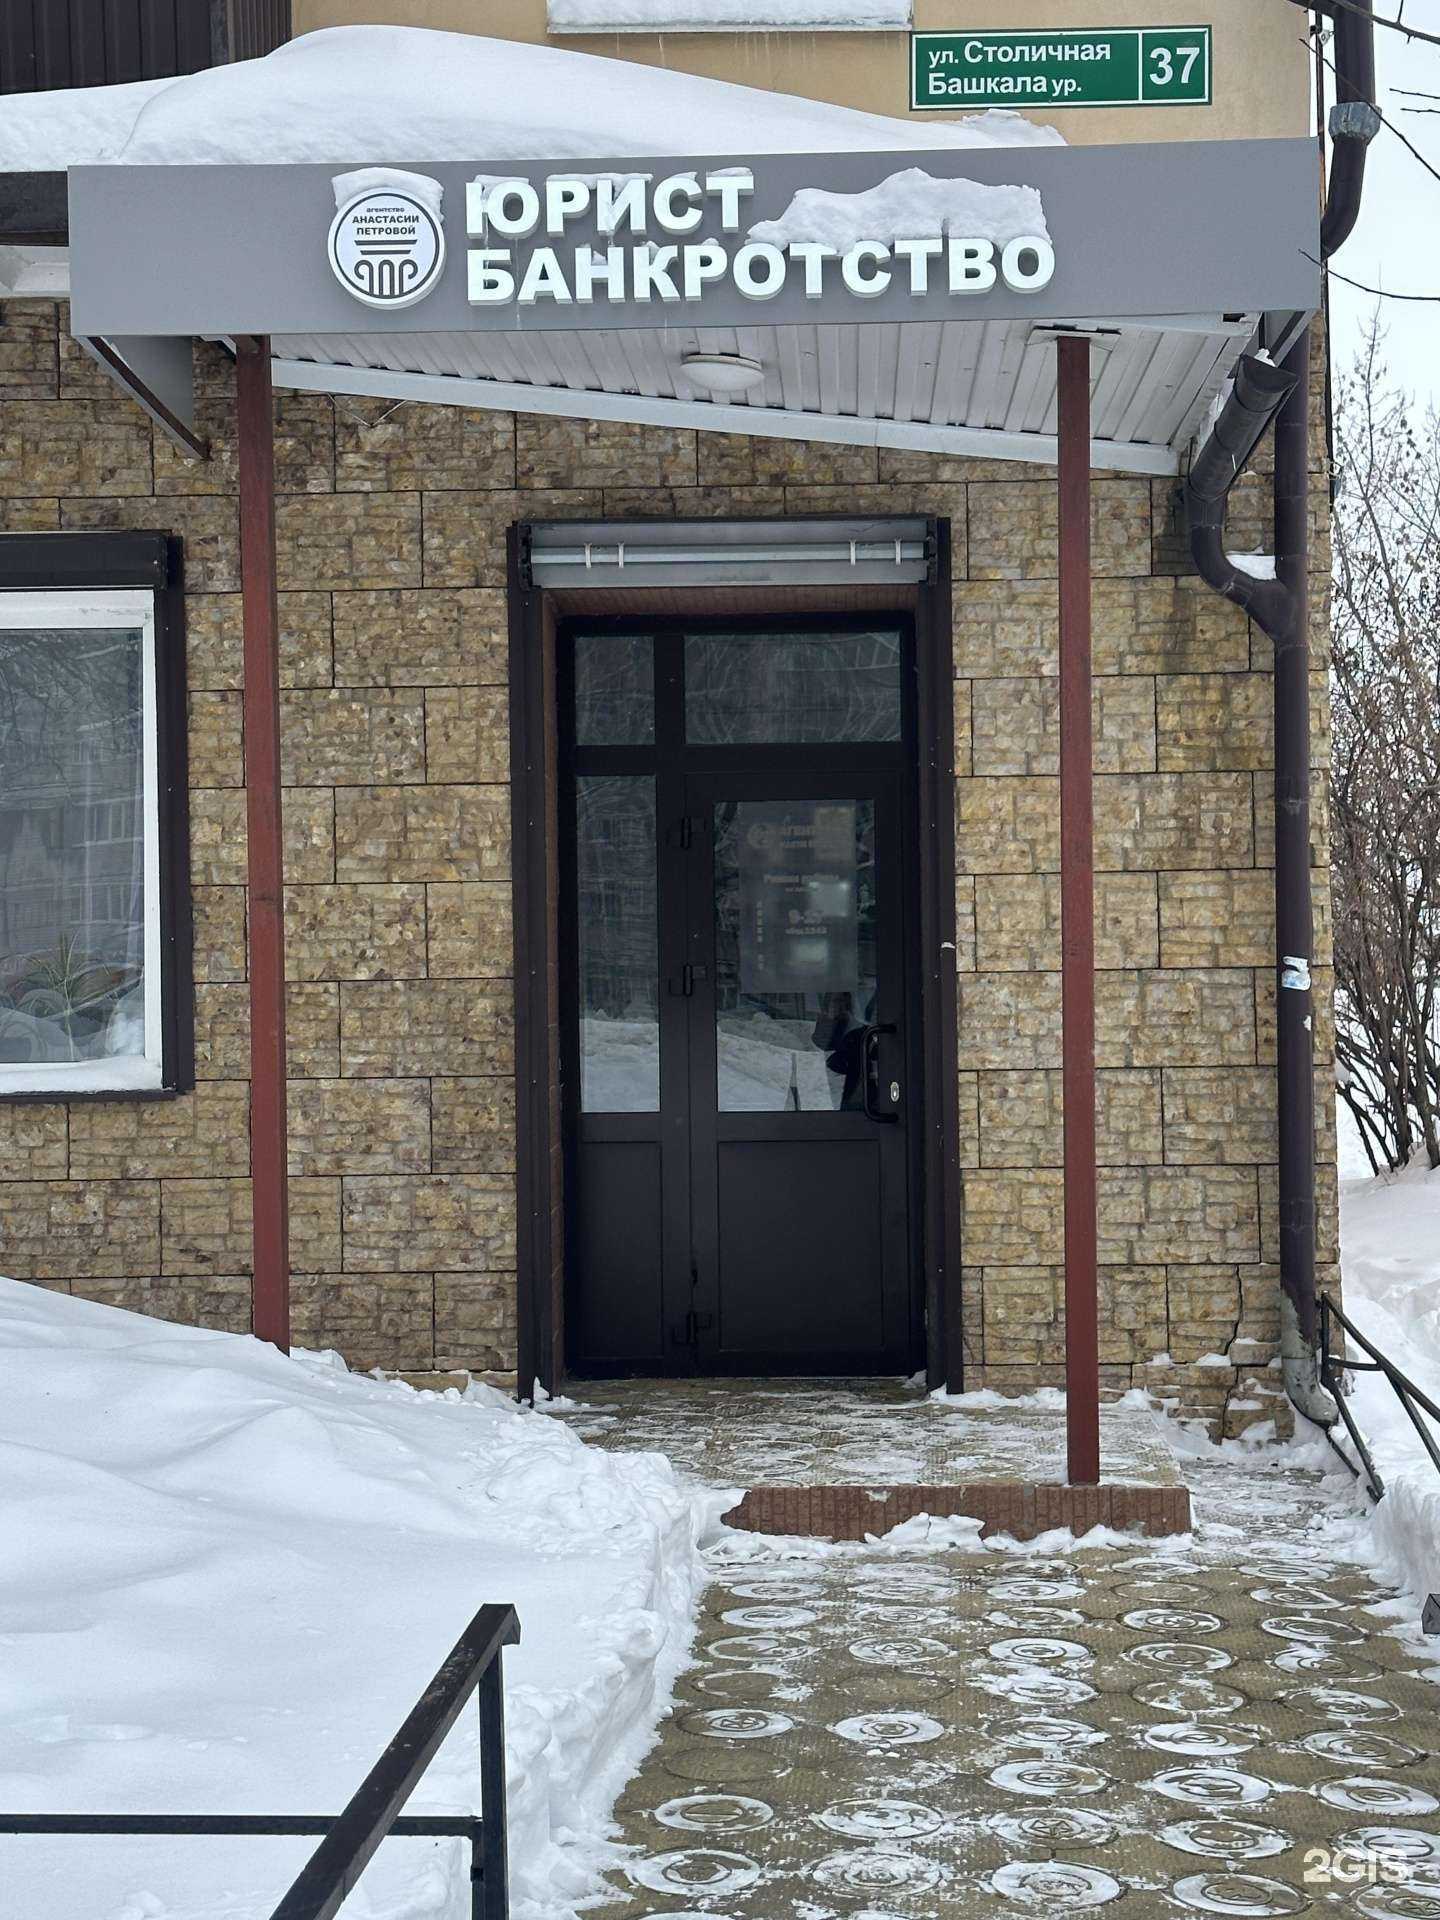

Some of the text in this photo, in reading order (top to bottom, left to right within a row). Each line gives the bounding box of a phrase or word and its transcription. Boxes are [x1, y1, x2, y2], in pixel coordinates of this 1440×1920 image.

[928, 40, 1111, 68] ул. Столичная
[1149, 47, 1200, 85] 37
[928, 72, 1082, 97] Башкала ур.
[352, 215, 420, 224] АНАСТАСИИ
[466, 174, 754, 239] ЮРИСТ
[356, 225, 416, 235] ПЕТРОВОЙ
[466, 236, 1055, 305] БАНКРОТСТВО
